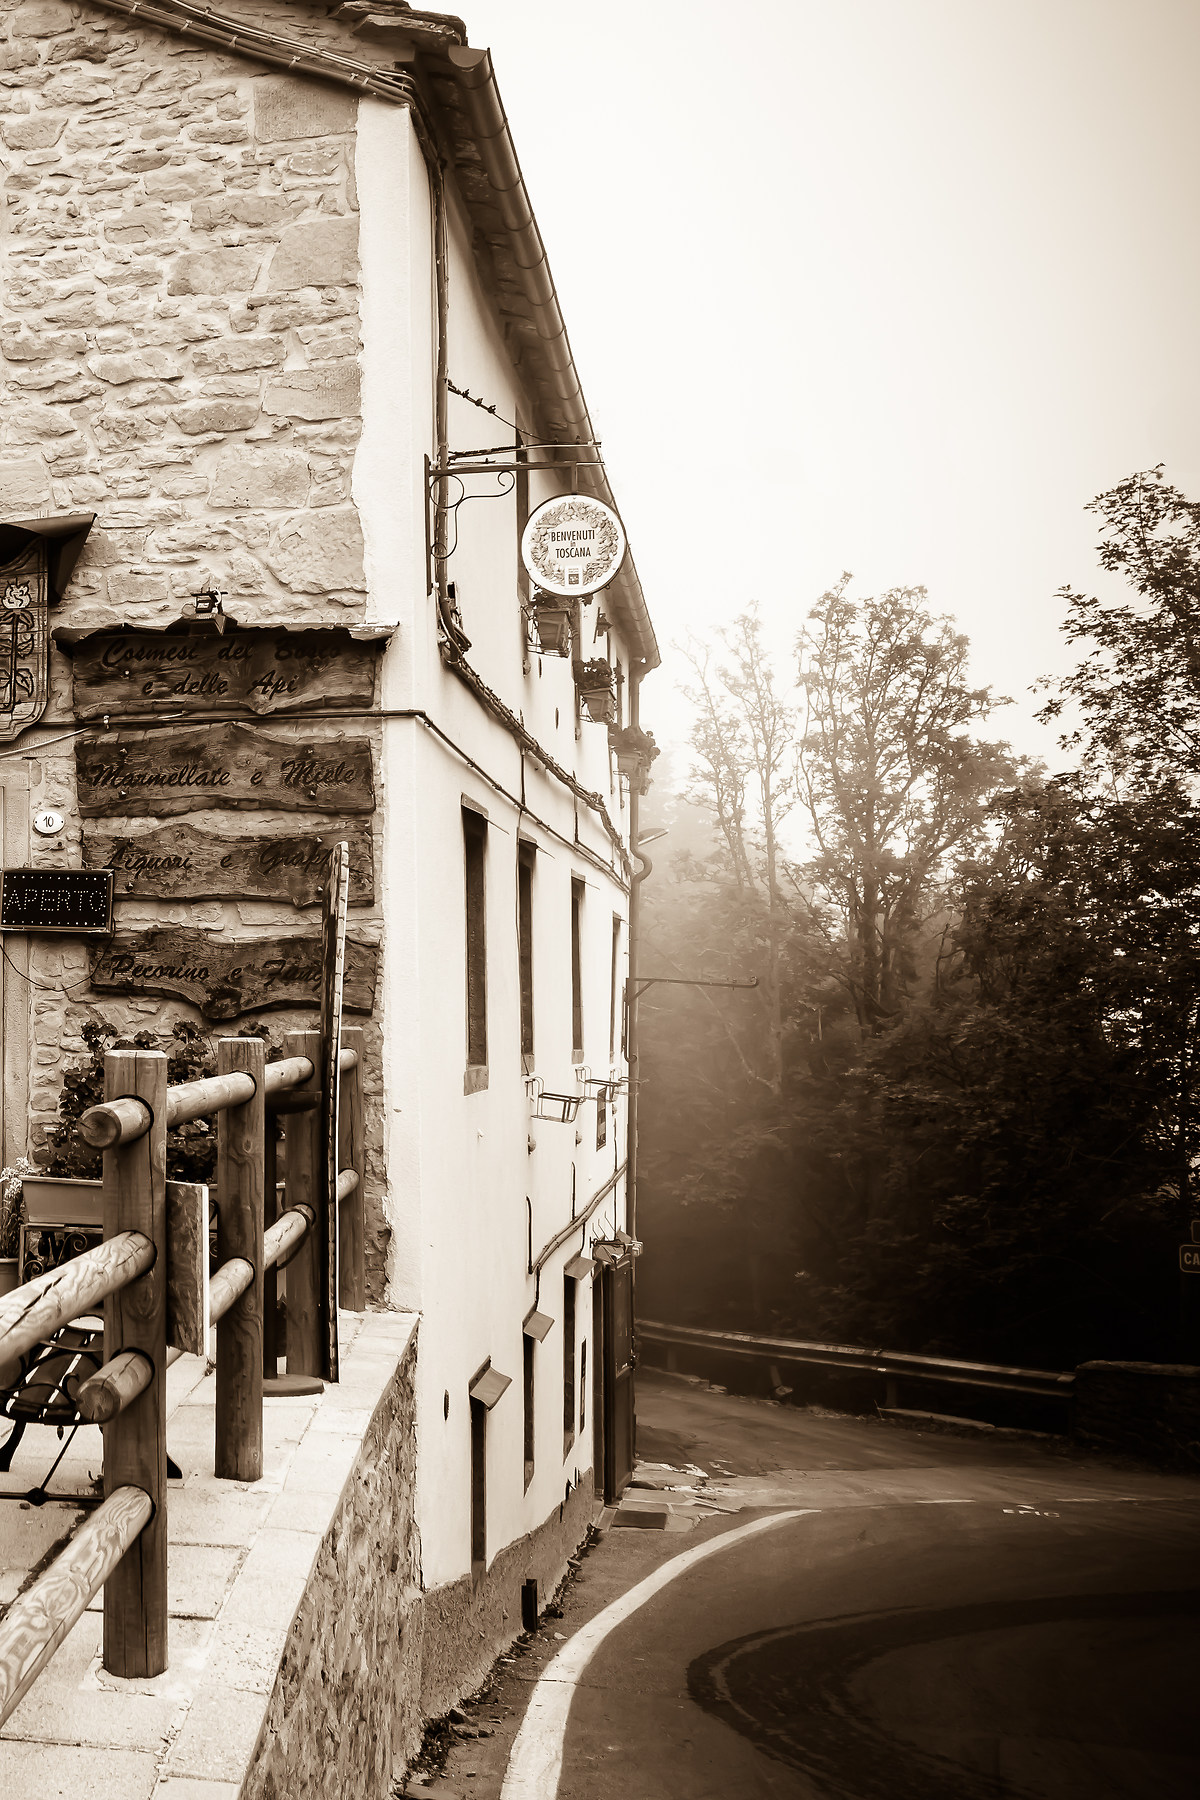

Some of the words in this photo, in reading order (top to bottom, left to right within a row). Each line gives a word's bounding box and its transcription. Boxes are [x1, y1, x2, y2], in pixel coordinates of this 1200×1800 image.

[551, 530, 595, 542] BENVENUTI
[555, 547, 591, 558] TOSCANA
[101, 637, 200, 668] Cosmesi
[217, 639, 255, 661] del
[141, 681, 154, 695] e
[172, 673, 229, 696] delle
[246, 670, 299, 700] Api
[92, 762, 232, 789] Marmellate
[249, 770, 263, 786] e
[282, 759, 357, 787] Miele
[42, 816, 54, 829] 10
[103, 842, 194, 879] Liguori
[219, 853, 233, 869] e
[6, 887, 106, 914] APERTO
[109, 954, 211, 981] Pecorino
[228, 965, 243, 981] e
